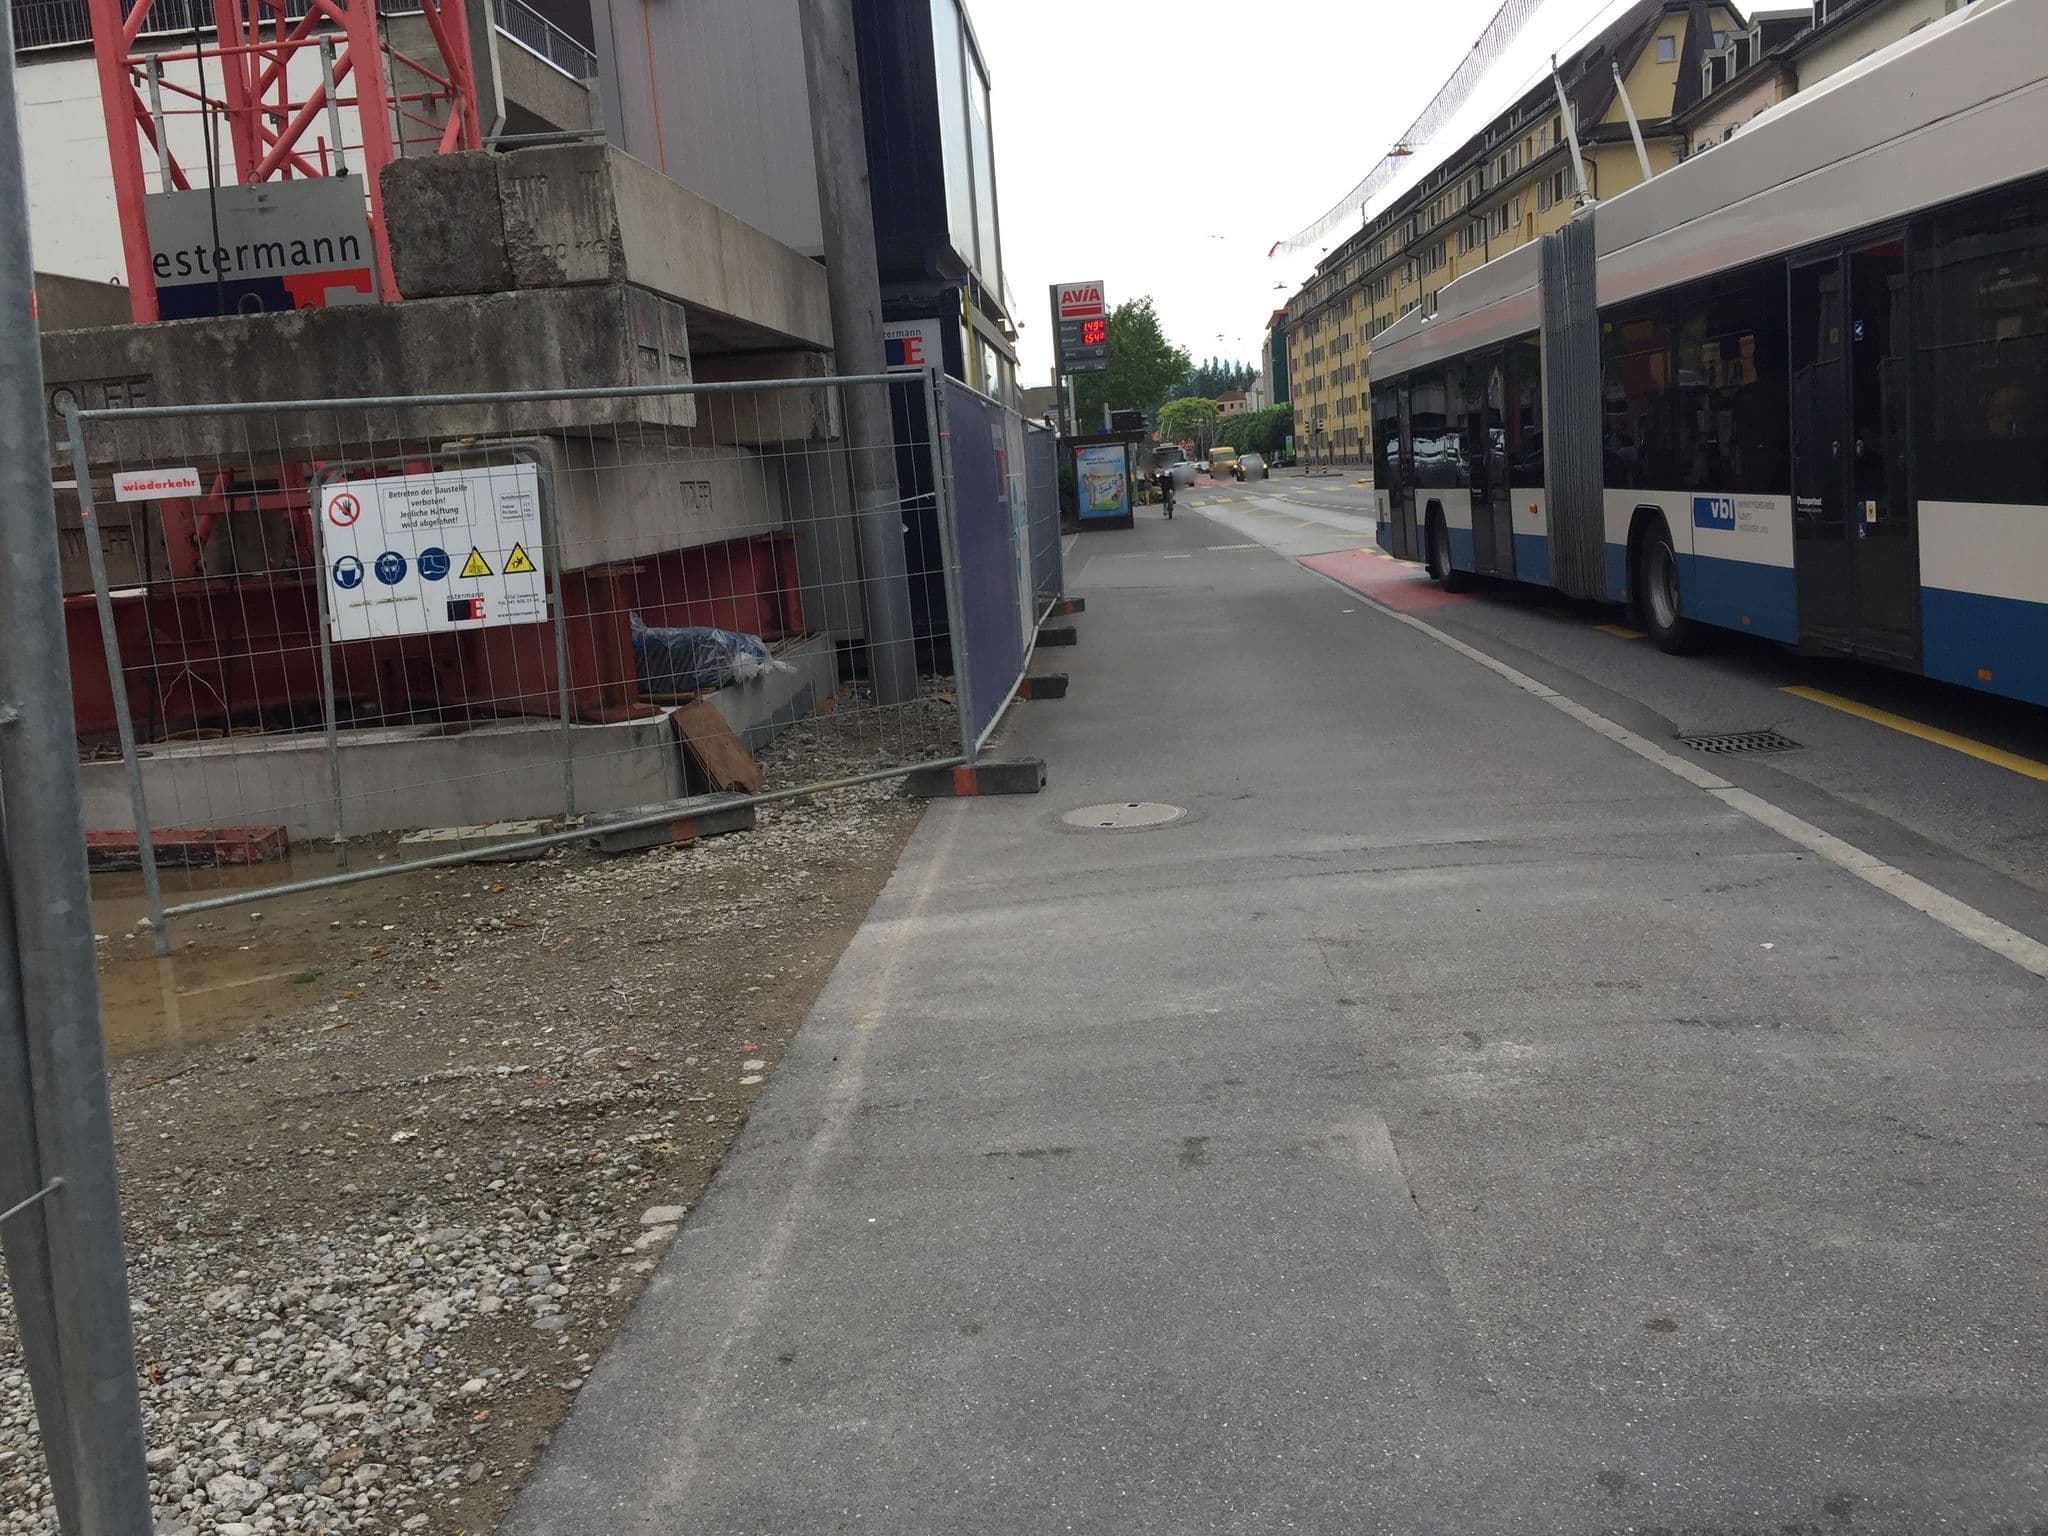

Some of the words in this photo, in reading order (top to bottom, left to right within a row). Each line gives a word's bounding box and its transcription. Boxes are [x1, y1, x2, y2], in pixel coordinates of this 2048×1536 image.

[152, 234, 361, 279] estermann
[1061, 286, 1100, 304] AVIA
[122, 478, 197, 492] wiederkehr
[388, 489, 419, 499] Betreten
[421, 487, 433, 496] der
[434, 484, 468, 494] Baustelle
[410, 497, 446, 507] verboten!
[1710, 497, 1734, 520] vbl
[400, 509, 428, 519] Jegliche
[430, 507, 459, 516] Haftung
[401, 519, 418, 529] wird
[419, 516, 458, 528] abgelehnt!
